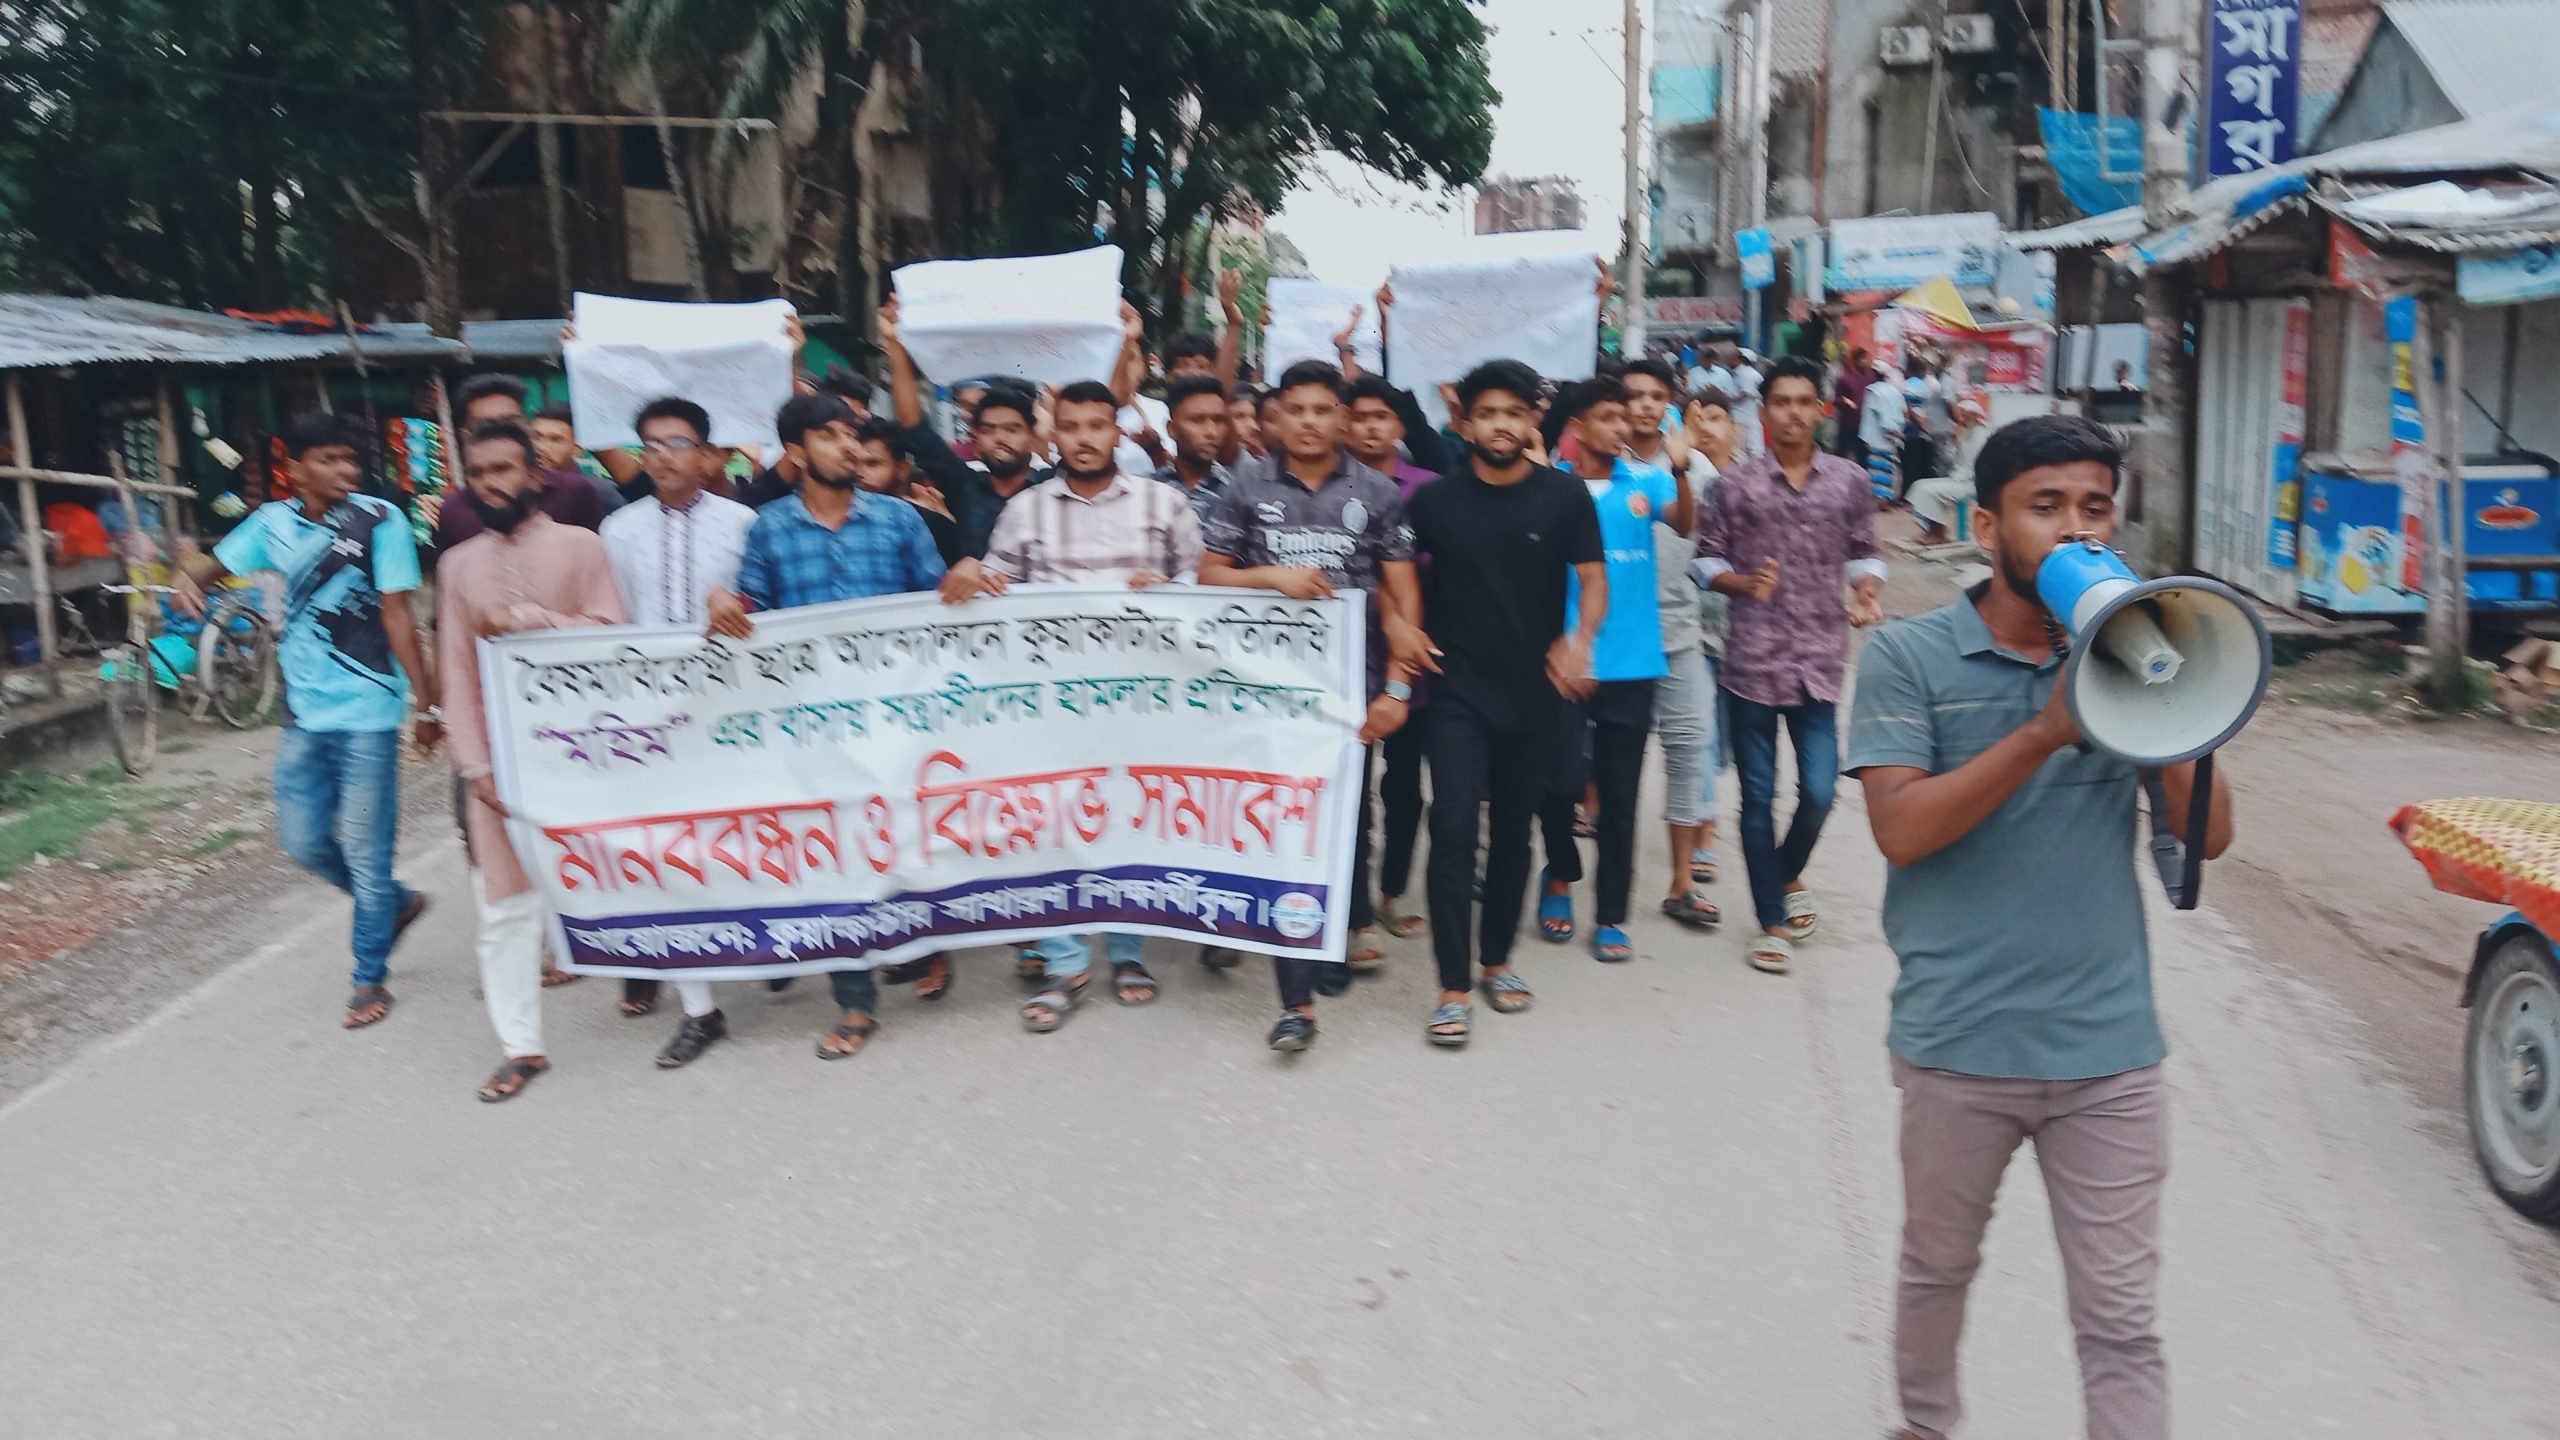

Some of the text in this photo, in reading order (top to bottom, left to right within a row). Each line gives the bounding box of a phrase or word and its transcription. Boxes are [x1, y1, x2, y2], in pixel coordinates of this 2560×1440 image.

[2214, 5, 2299, 173] সাগর
[511, 634, 741, 704] বৈষম্যবিরোধী
[824, 620, 1008, 672] আন্দোলনে
[1012, 602, 1184, 668] কুয়াকাটার
[1193, 603, 1332, 664] প্রতিনিধি
[707, 711, 767, 751] এর
[1050, 676, 1176, 718] হামলার
[1184, 667, 1326, 720] প্রতিবাদে
[542, 749, 1328, 890] মানববন্ধন ও বিক্ষোভ সমাবেশ
[760, 900, 938, 962] কুয়াকাটার
[935, 884, 1073, 924] সাধারণ
